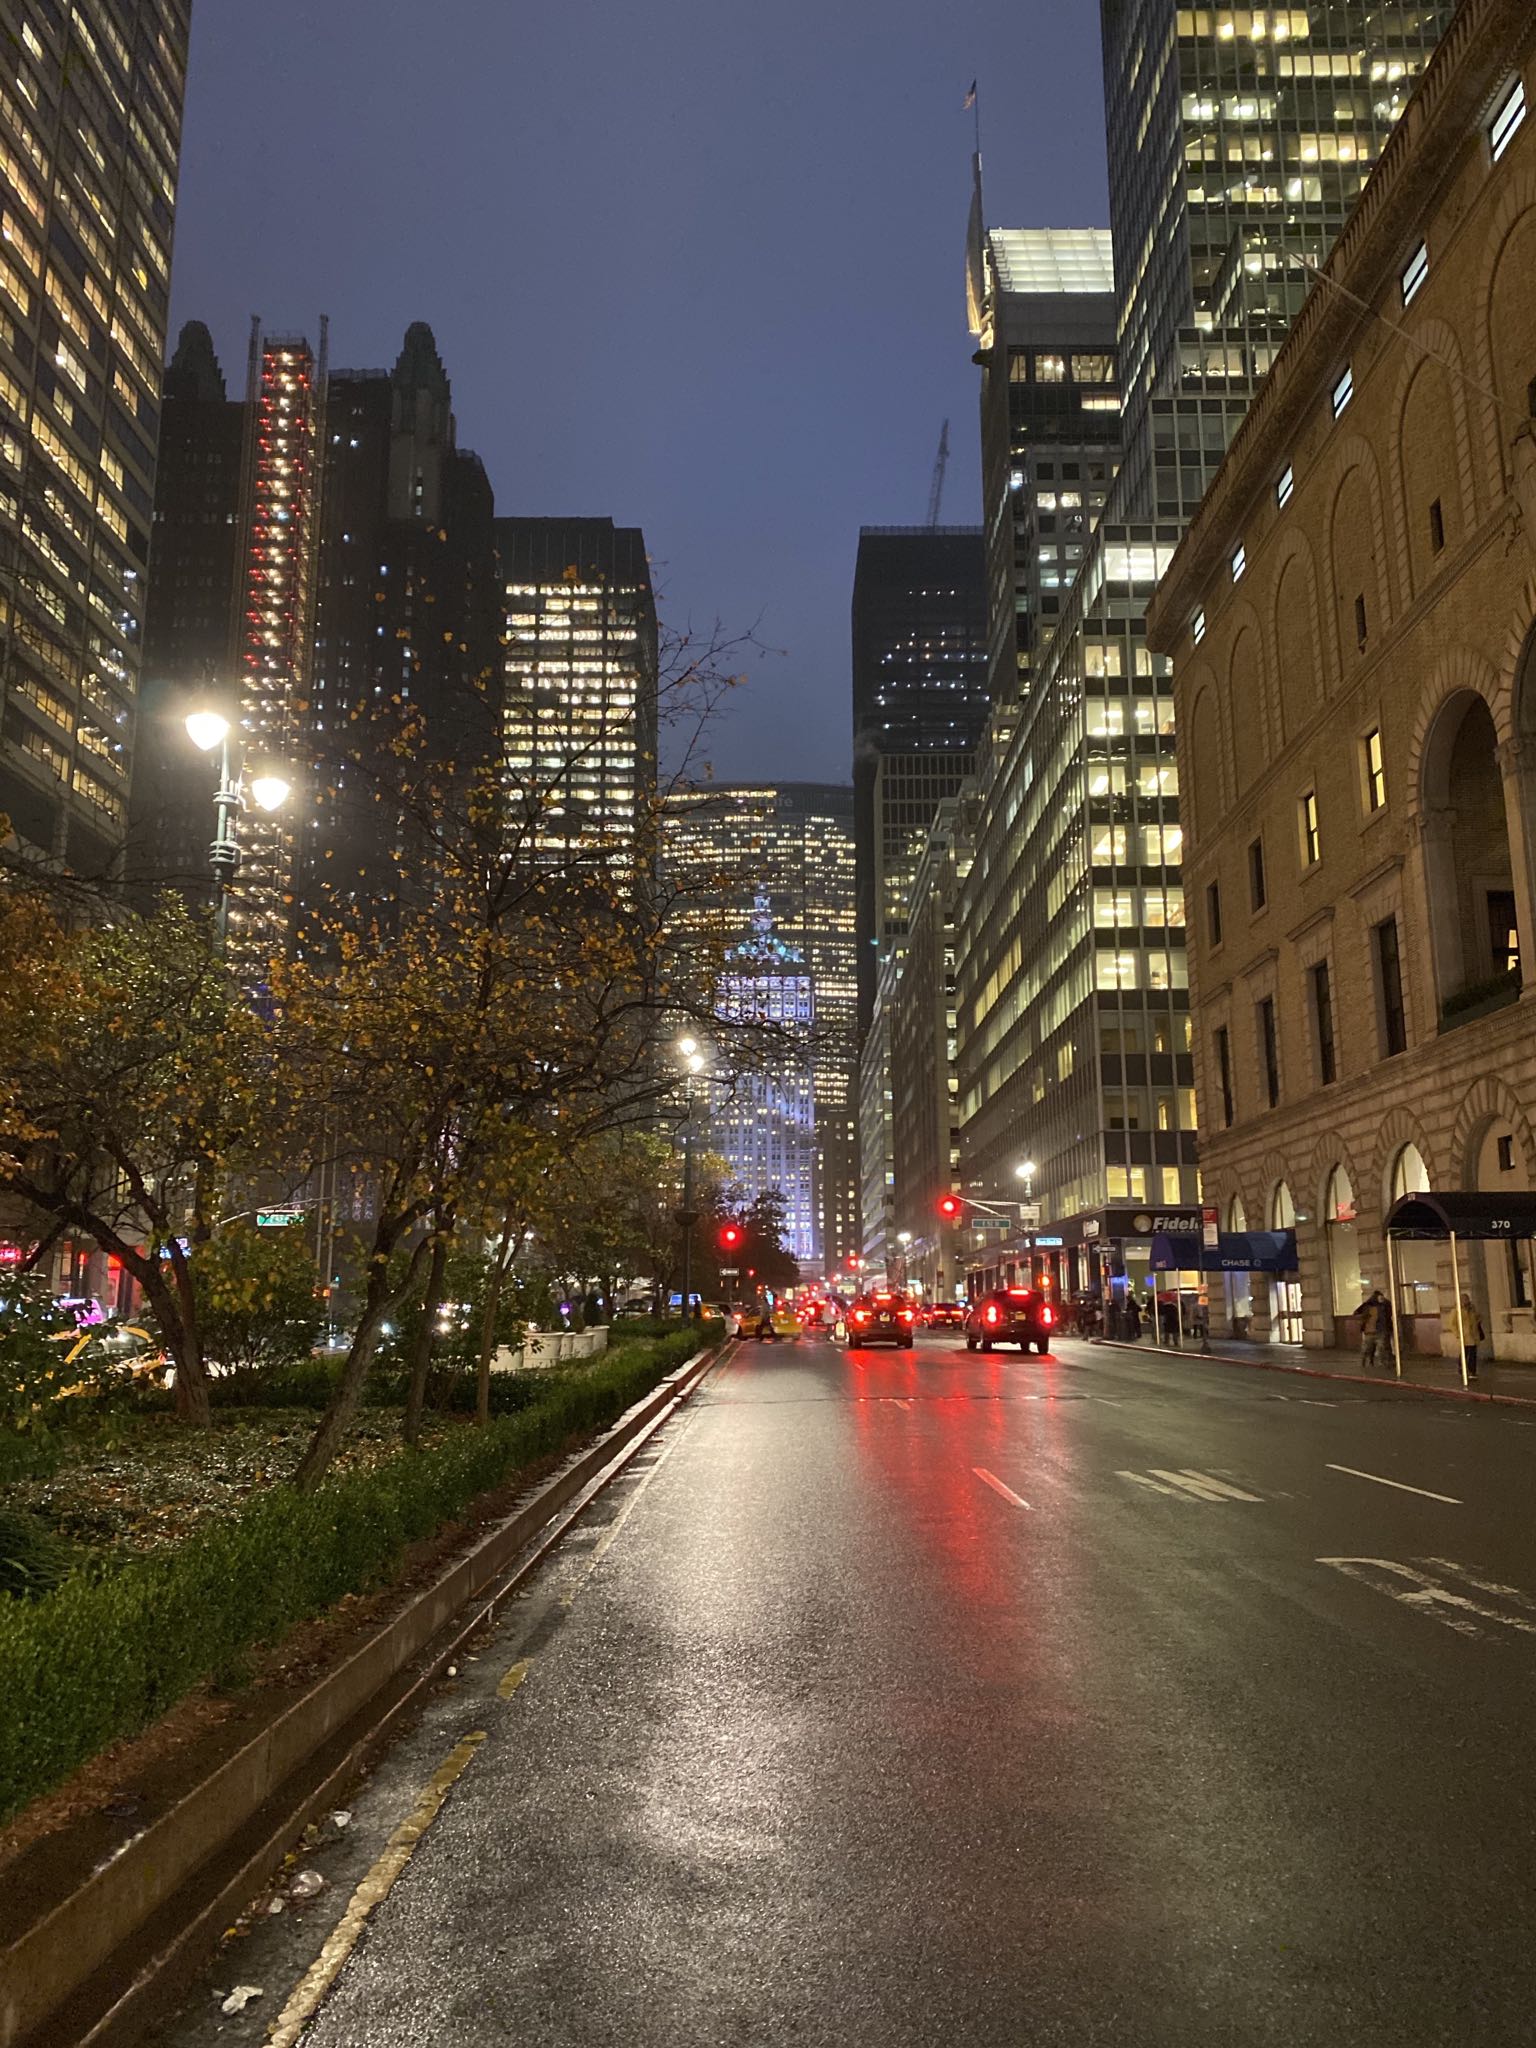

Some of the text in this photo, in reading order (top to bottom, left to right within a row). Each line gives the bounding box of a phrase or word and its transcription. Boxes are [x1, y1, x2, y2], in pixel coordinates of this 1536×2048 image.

[1153, 1216, 1202, 1230] Fideli
[1491, 1220, 1511, 1229] 370
[1221, 1259, 1251, 1267] CHASE
